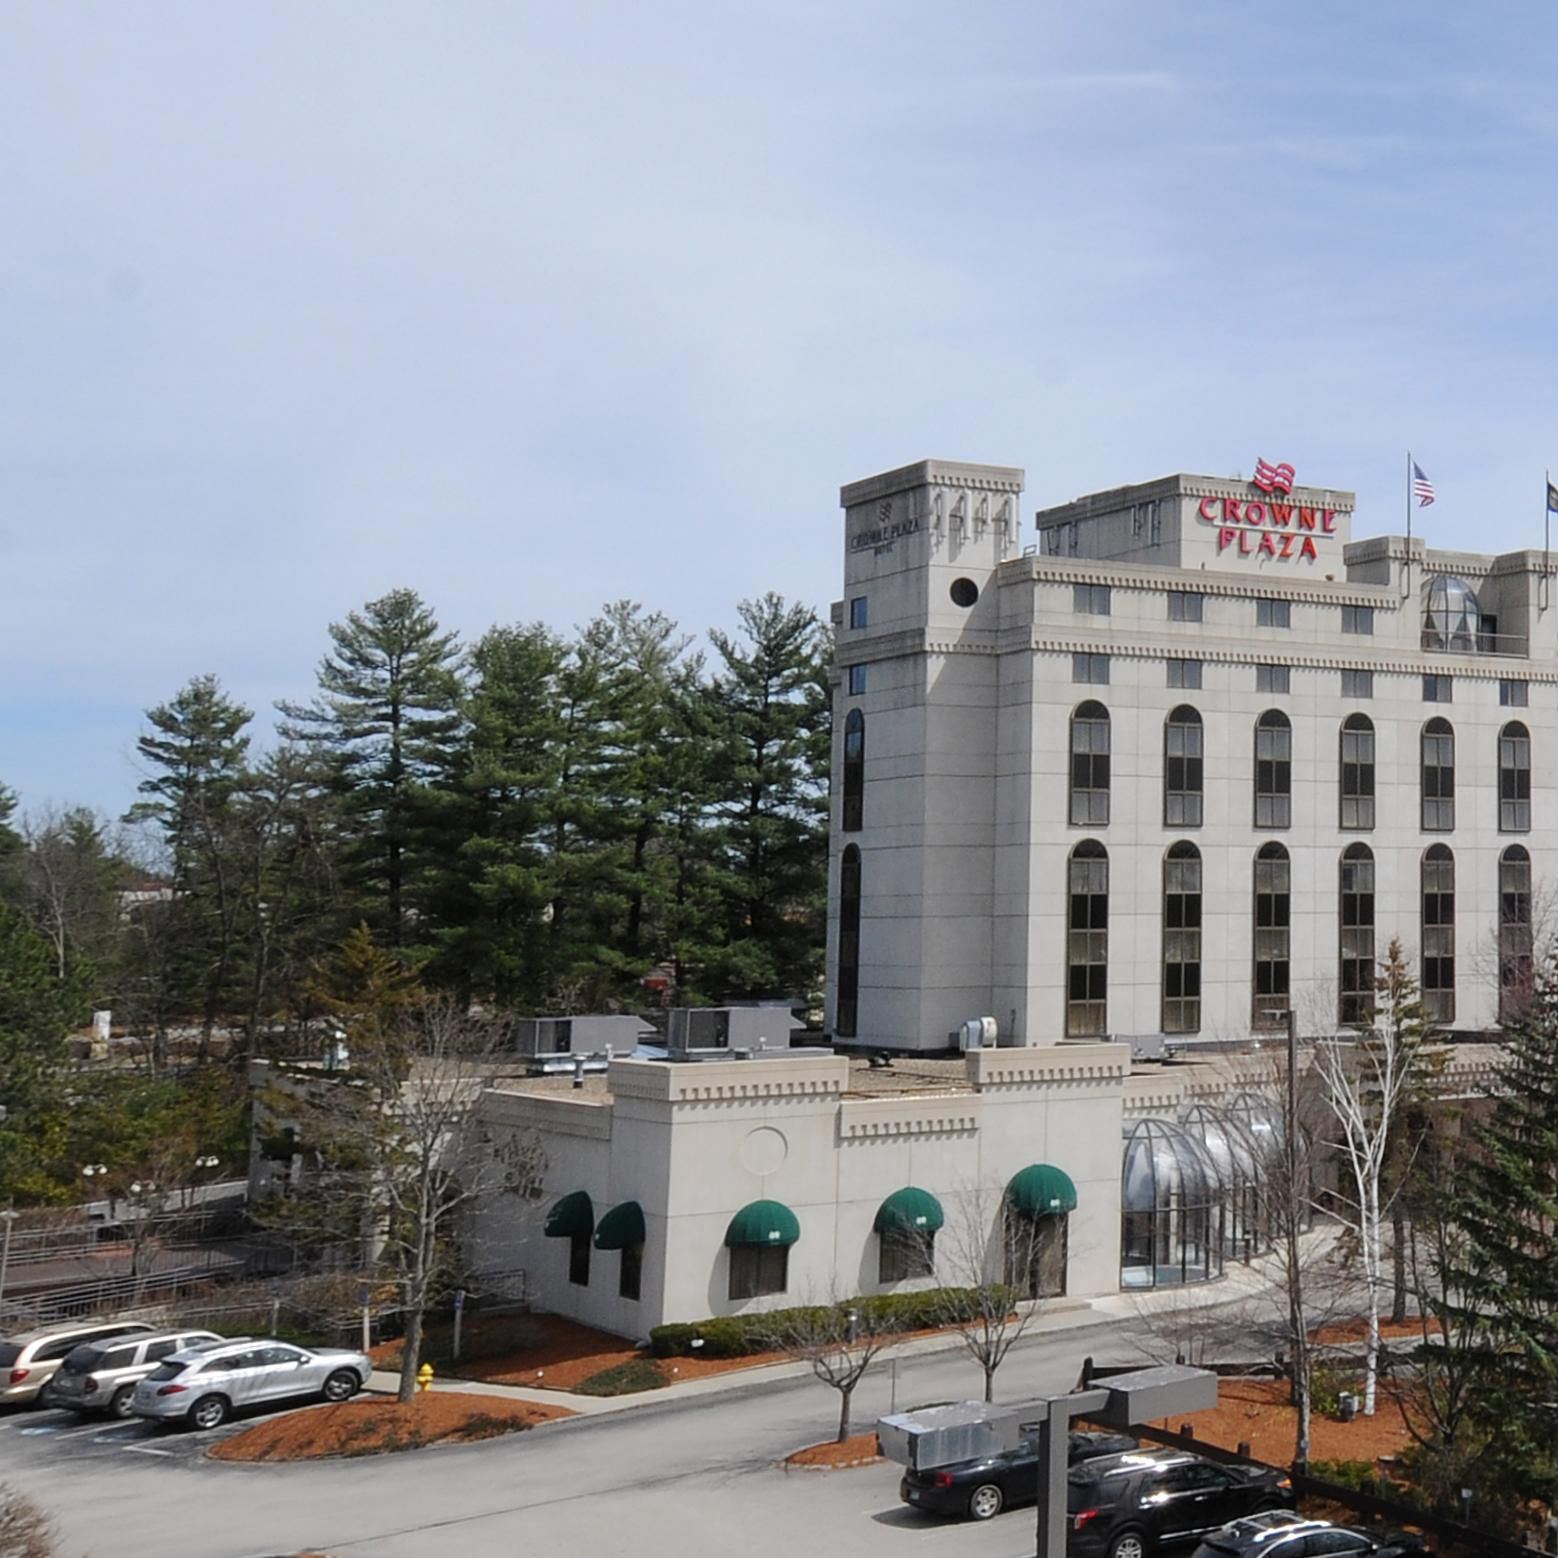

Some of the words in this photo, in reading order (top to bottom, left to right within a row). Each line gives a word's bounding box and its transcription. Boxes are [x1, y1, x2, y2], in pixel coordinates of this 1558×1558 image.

[890, 518, 920, 538] PLAZA
[1199, 496, 1337, 532] CROWNE
[1219, 527, 1317, 560] PLAZA
